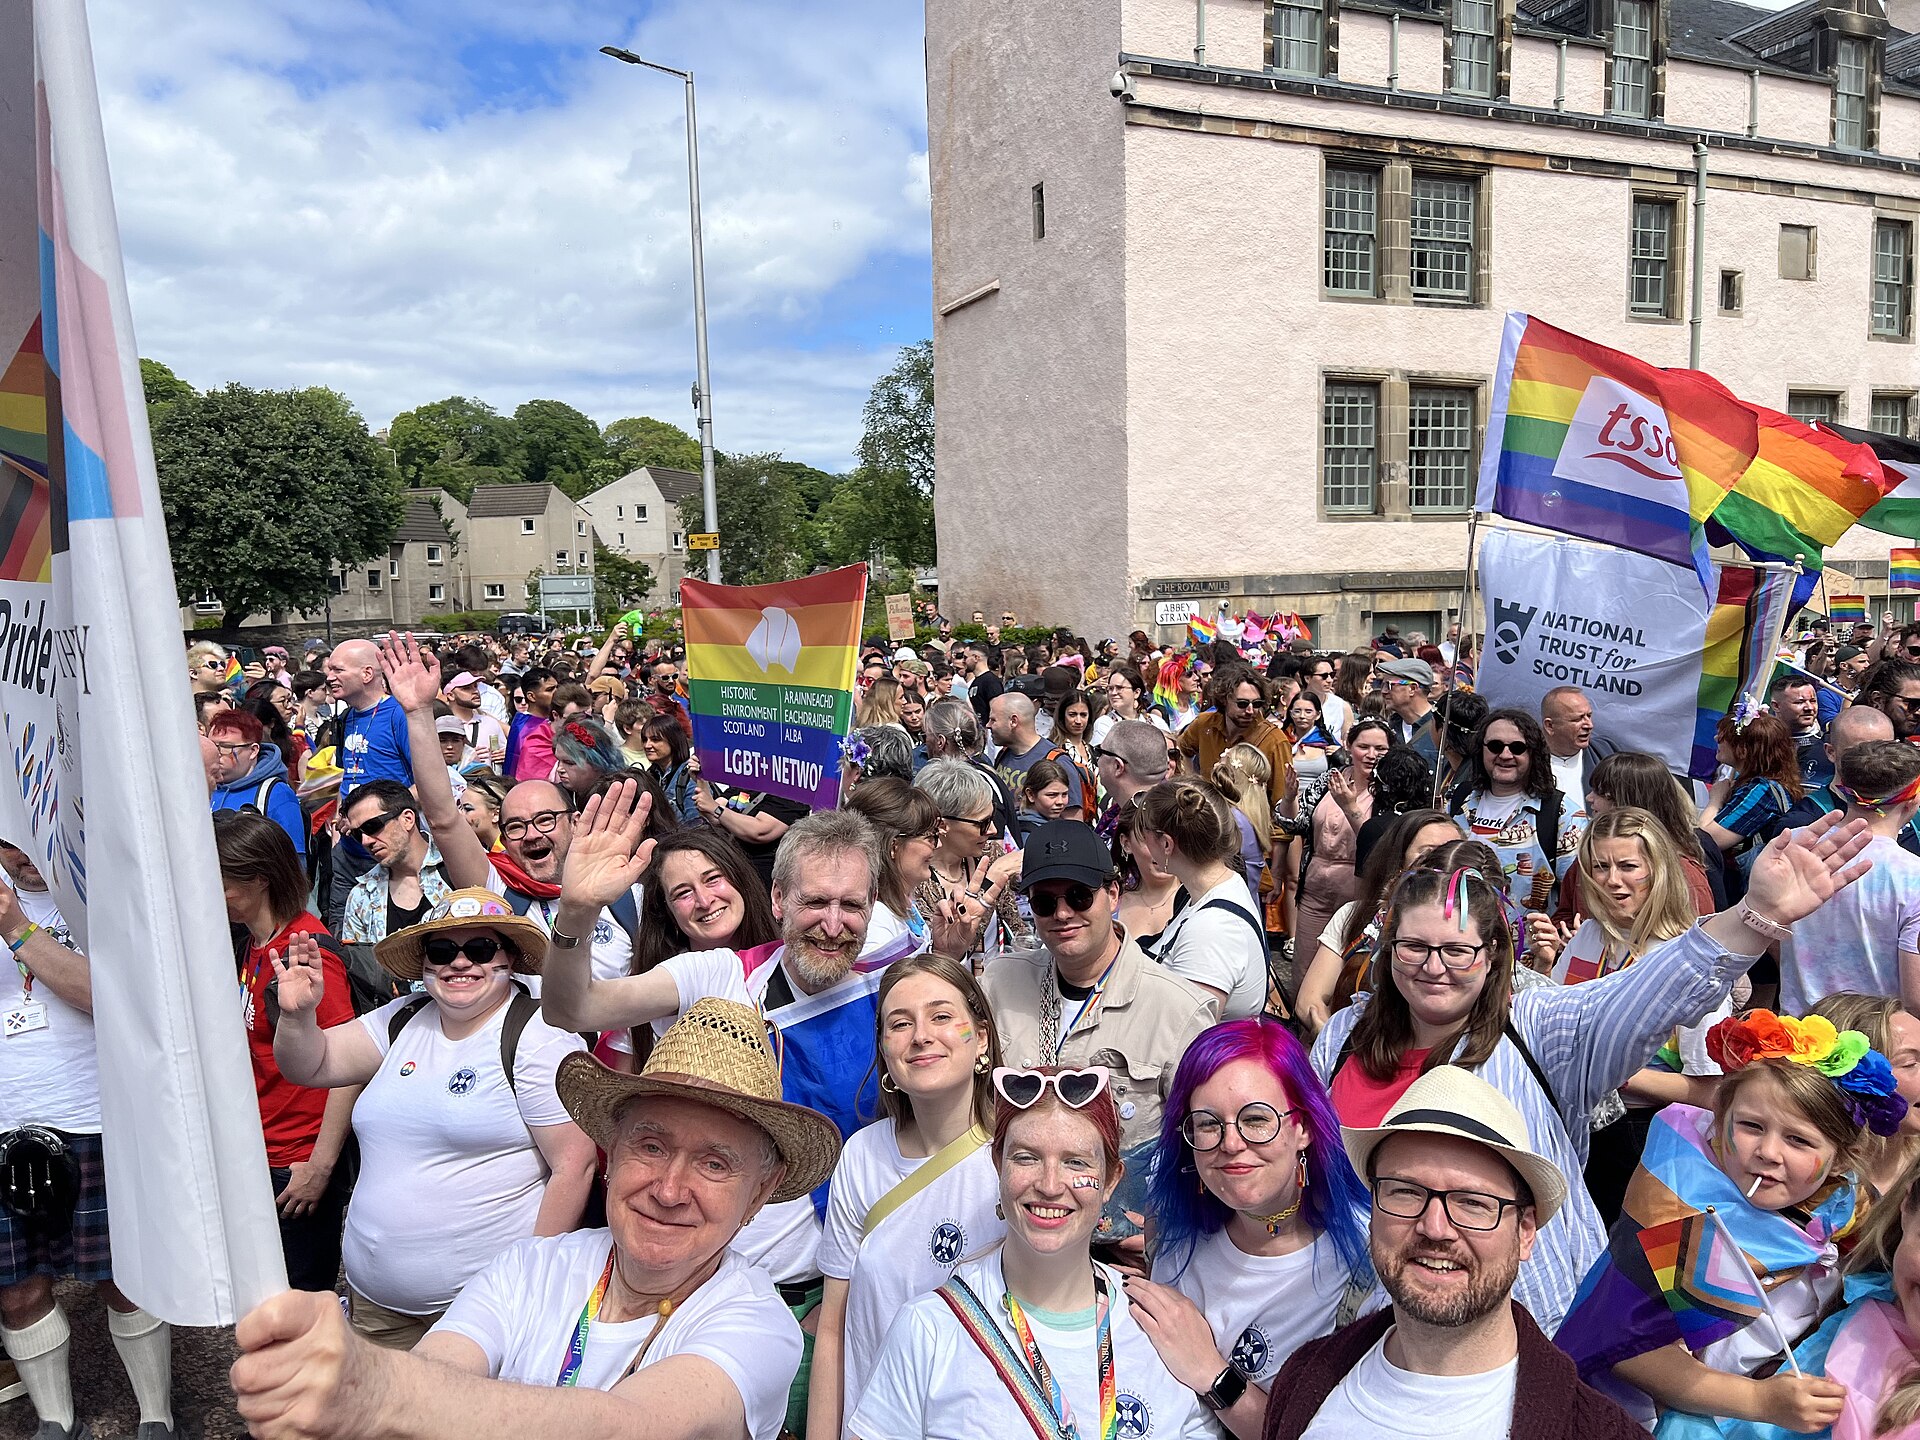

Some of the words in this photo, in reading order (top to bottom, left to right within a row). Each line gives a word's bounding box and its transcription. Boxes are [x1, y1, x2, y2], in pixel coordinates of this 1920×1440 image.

[1159, 583, 1175, 592] THE
[1177, 582, 1204, 592] ROYAL
[1209, 581, 1229, 591] MILE
[1160, 613, 1196, 623] STRAN
[1164, 603, 1191, 613] ABBEY
[1541, 611, 1646, 648] NATIONAL
[1539, 634, 1602, 663] TRUST
[1597, 648, 1636, 670] for
[1532, 658, 1642, 697] SCOTLAND
[721, 686, 757, 701] HISTORIC
[784, 687, 834, 709] ÀRAINNEACHD
[722, 703, 778, 721] ENVIRONMENT
[723, 720, 765, 738] SCOTLAND
[784, 728, 803, 744] ALBA
[724, 747, 769, 778] LGBT+
[1073, 1176, 1099, 1189] LOVE
[941, 1217, 968, 1246] UNIVERSITY
[1101, 1327, 1111, 1376] EDINBURGH
[1116, 1387, 1155, 1416] NIVERSITY
